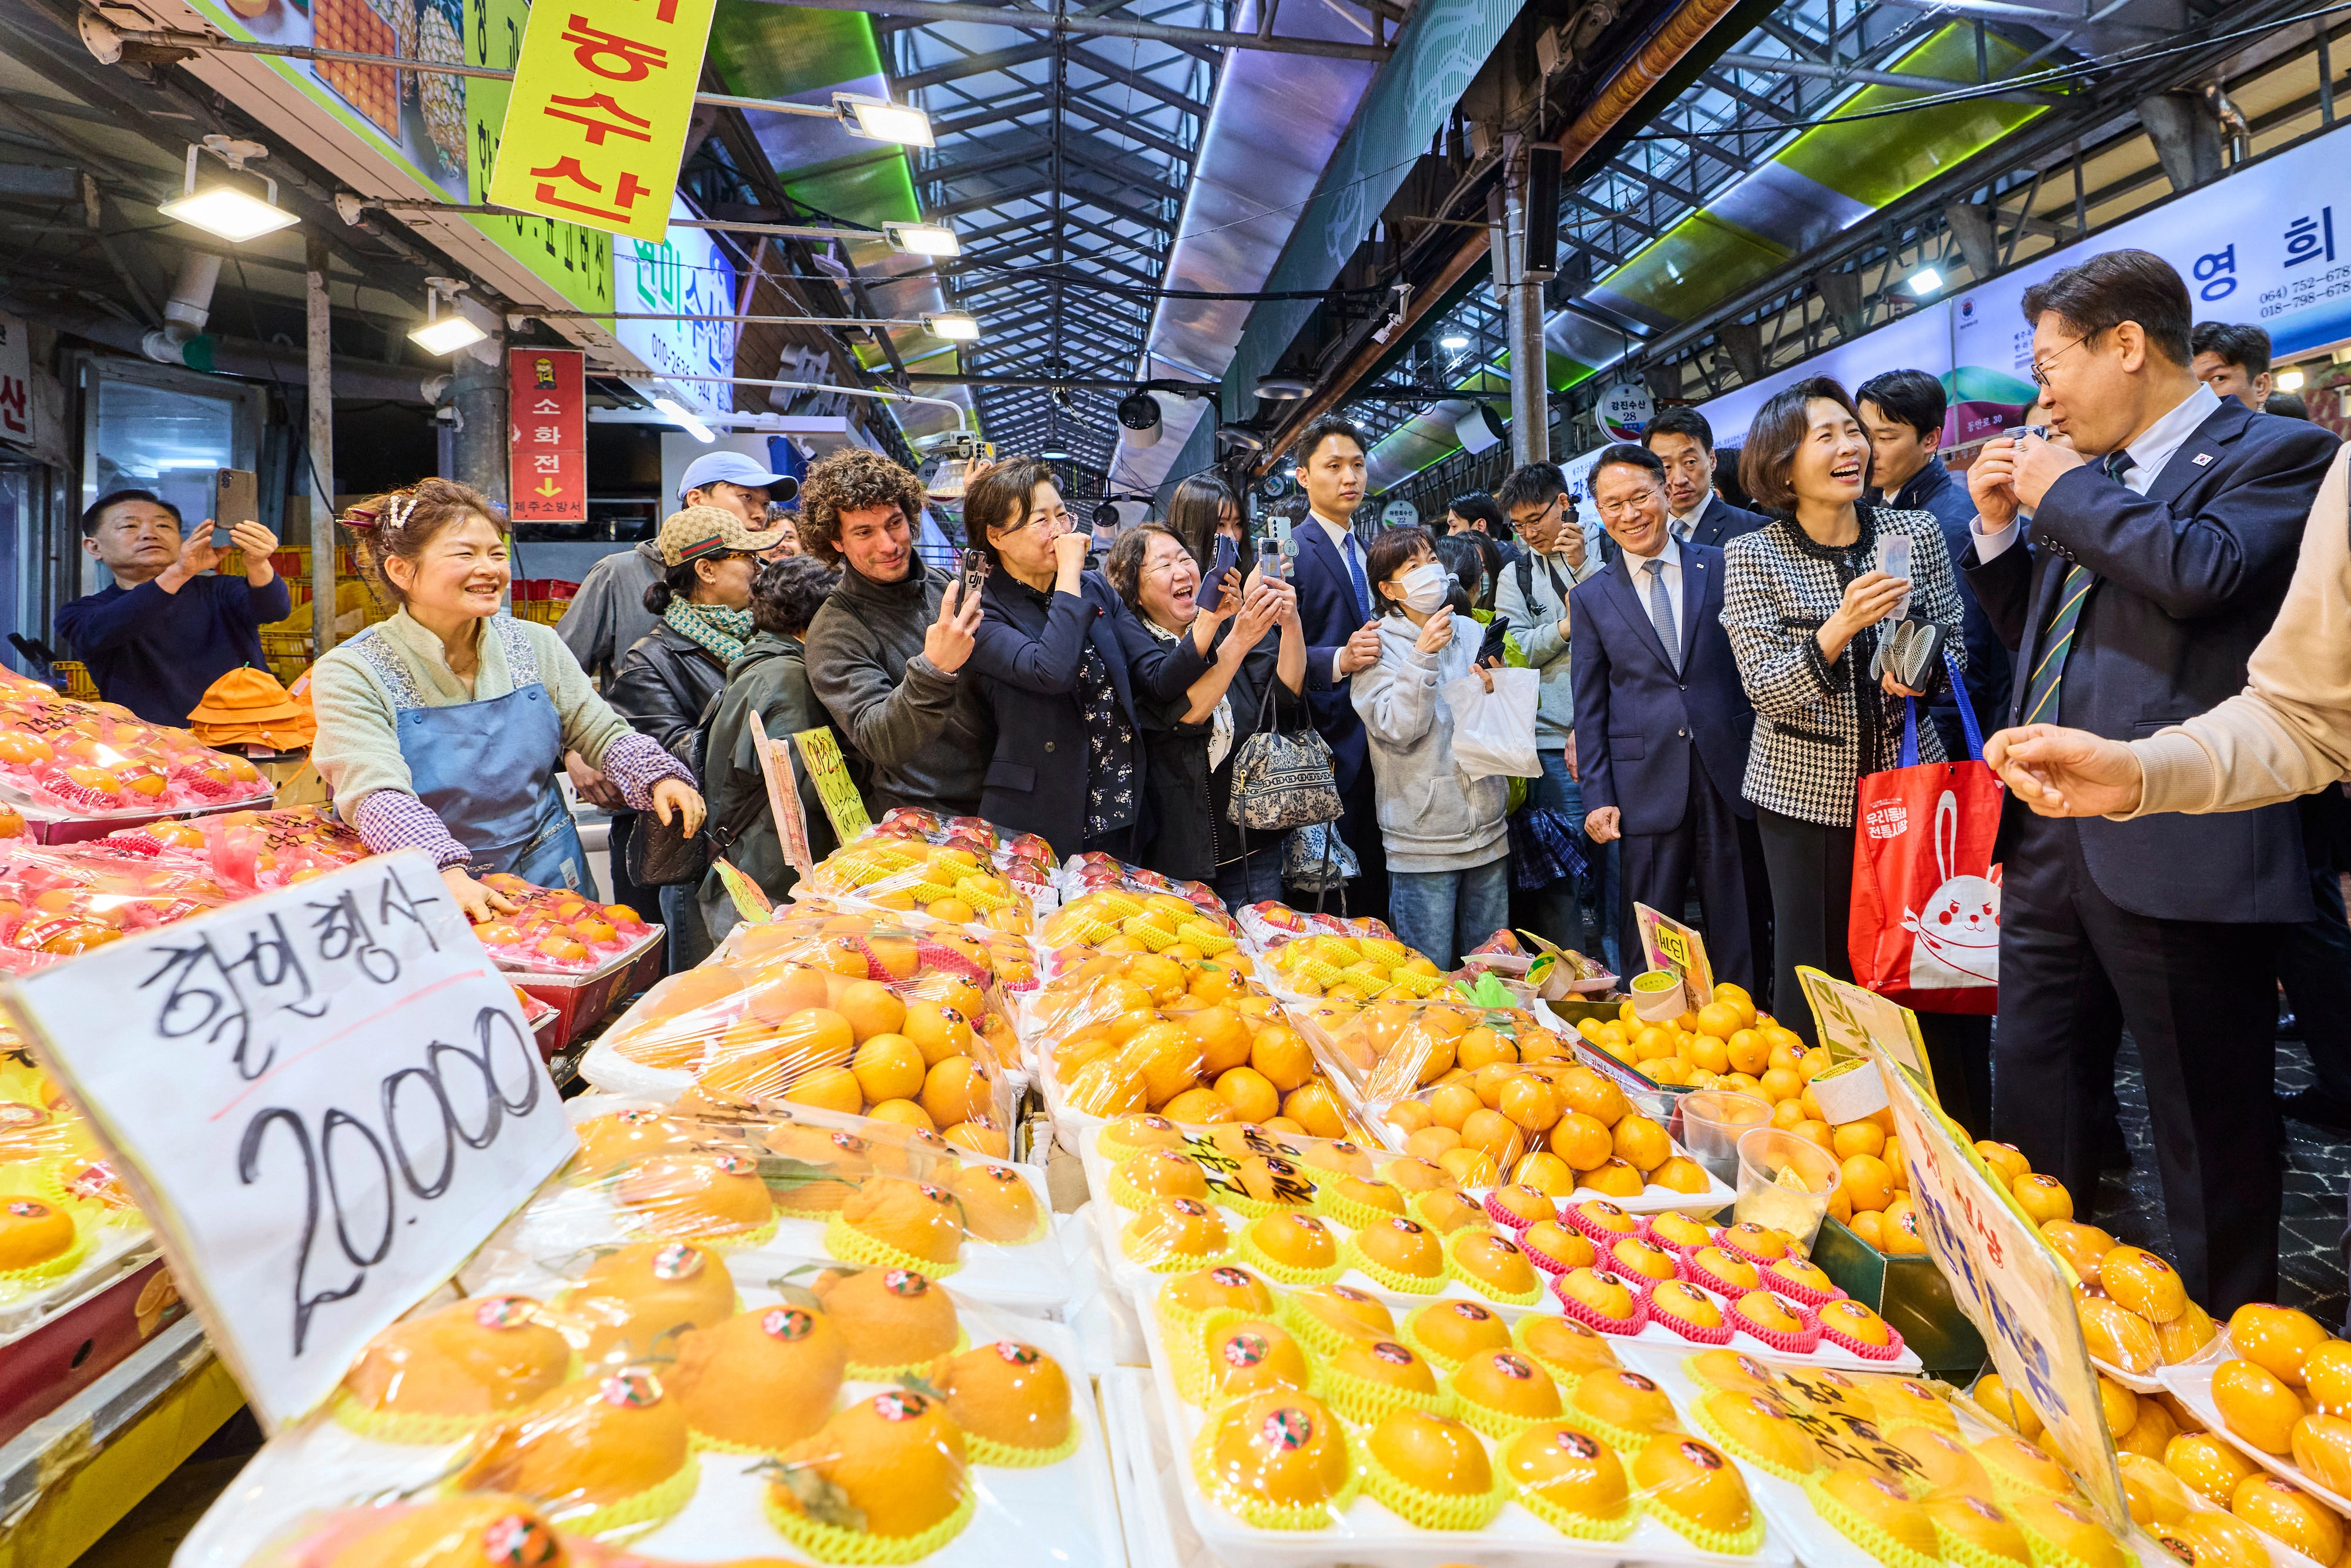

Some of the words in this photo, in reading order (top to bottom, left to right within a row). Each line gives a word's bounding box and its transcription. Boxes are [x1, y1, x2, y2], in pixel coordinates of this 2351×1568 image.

[530, 0, 678, 224] 농수산
[2293, 264, 2351, 294] 752-678
[2261, 280, 2351, 318] 018-798-678
[1611, 400, 1646, 410] 강진수산
[1623, 412, 1636, 421] 28
[1993, 414, 2002, 424] 30
[533, 398, 561, 473] 소화전
[514, 501, 581, 512] 제주소방서
[969, 571, 982, 588] dji
[1866, 807, 1907, 825] 우리동네
[1868, 819, 1908, 839] 전통시장
